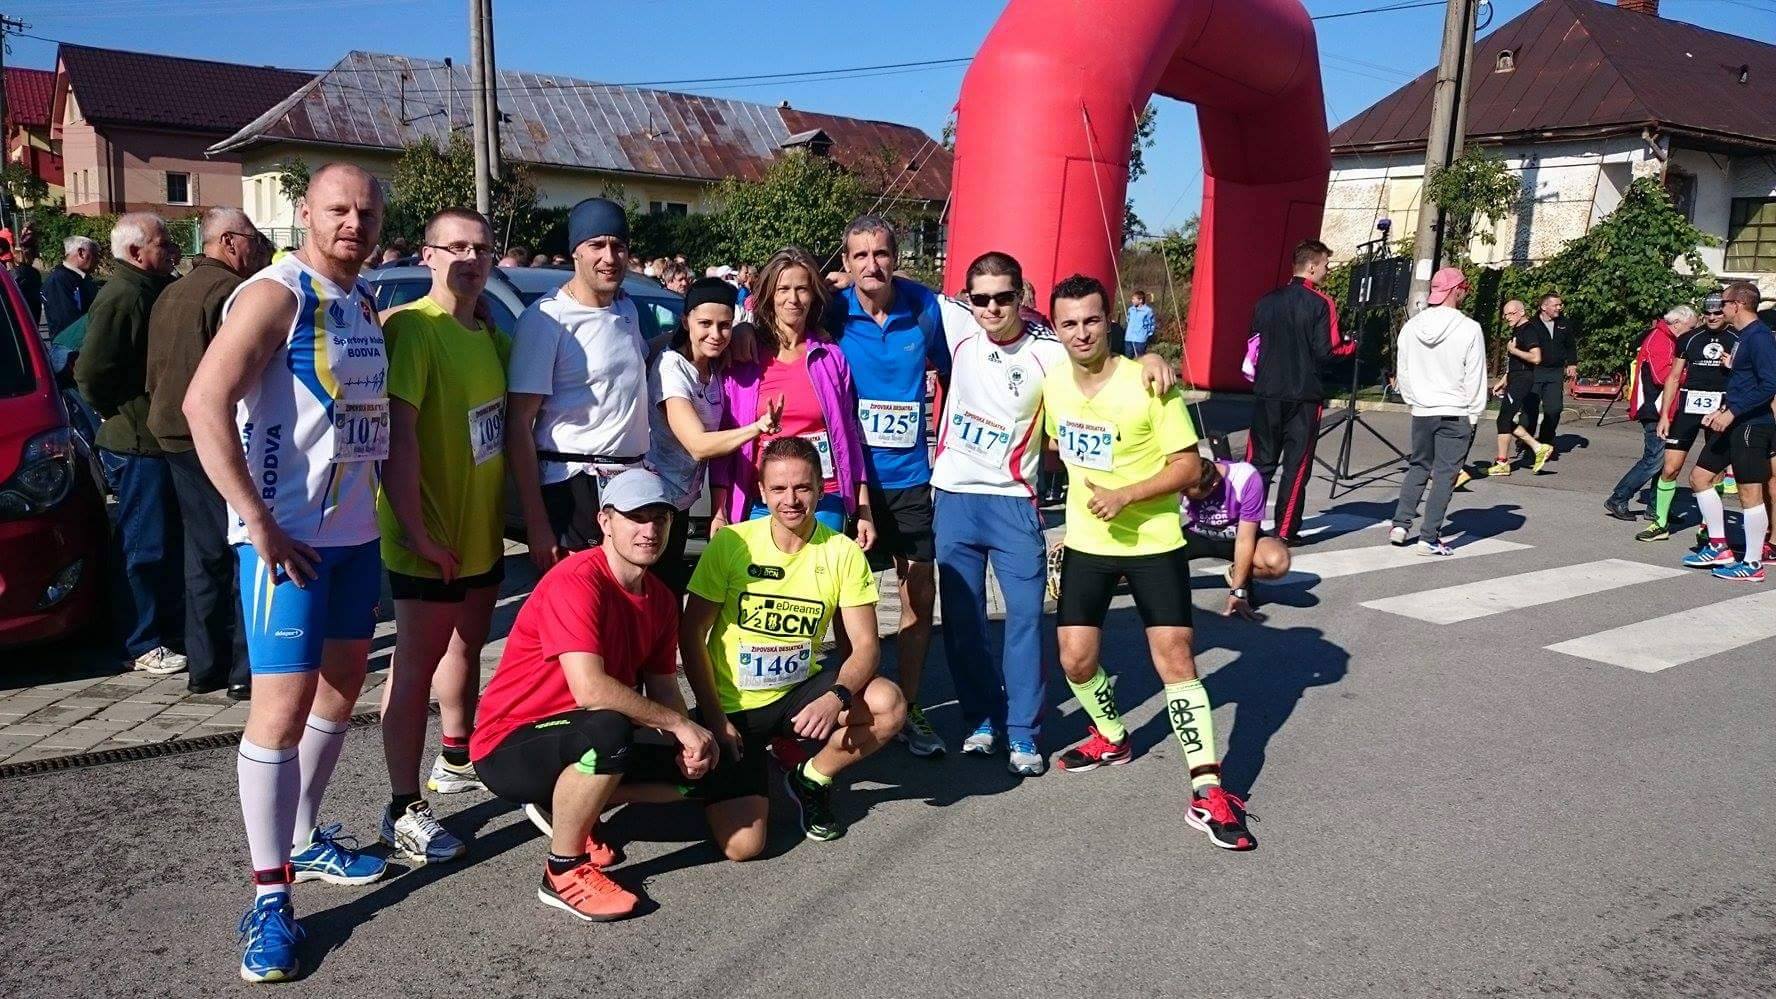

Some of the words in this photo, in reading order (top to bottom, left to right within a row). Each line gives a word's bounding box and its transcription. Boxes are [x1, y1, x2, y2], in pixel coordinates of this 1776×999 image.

[370, 336, 384, 344] klub
[347, 348, 381, 358] BODVA
[1693, 397, 1713, 408] 43
[345, 417, 380, 444] 107
[480, 414, 500, 445] 109
[870, 413, 909, 434] 125
[960, 422, 999, 449] 117
[1068, 431, 1101, 455] 152
[262, 424, 282, 499] BODVA
[776, 601, 820, 615] eDreams
[765, 612, 819, 635] BCN
[751, 645, 777, 653] ŽIPOVSKÁ
[779, 644, 804, 652] DESIATKA
[752, 653, 798, 677] 146
[1170, 698, 1206, 754] eleven
